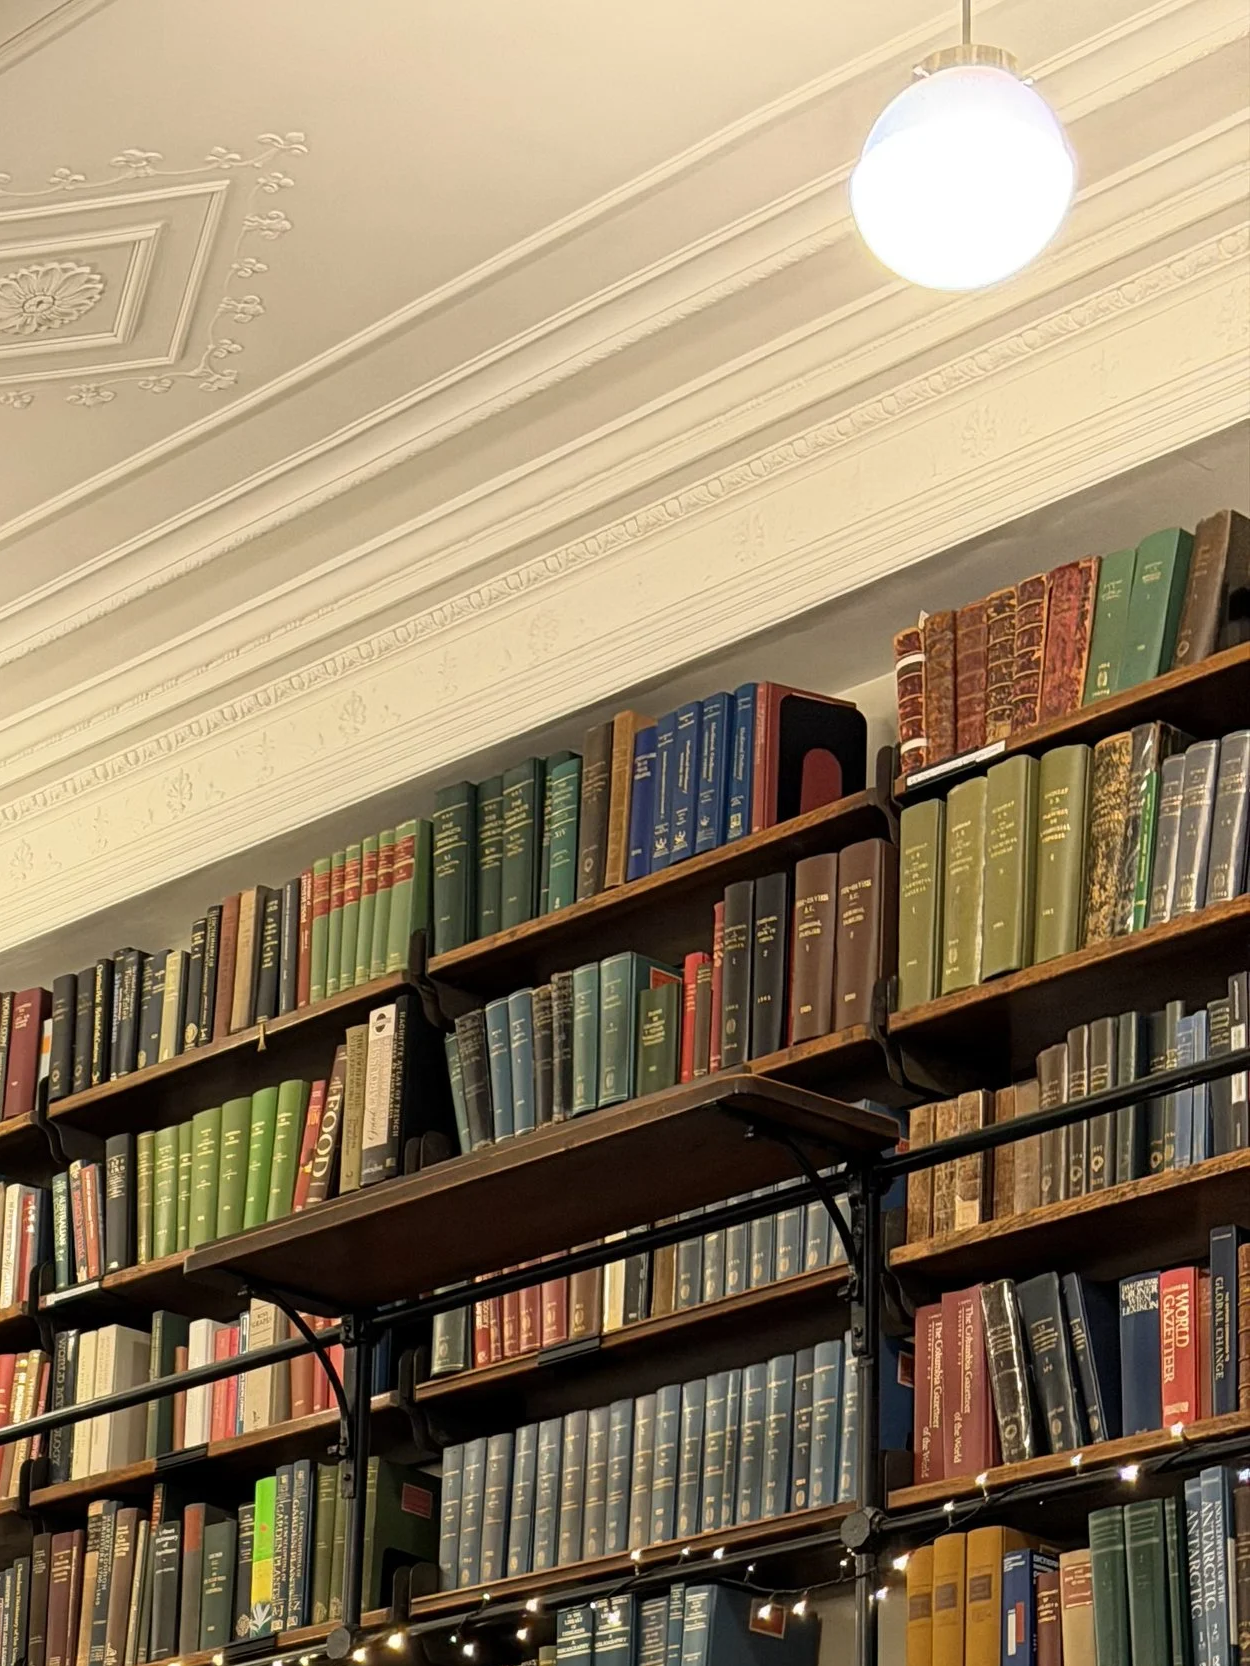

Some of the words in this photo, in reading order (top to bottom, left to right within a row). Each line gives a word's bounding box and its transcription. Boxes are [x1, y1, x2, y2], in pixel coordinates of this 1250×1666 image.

[312, 1094, 342, 1178] FOOD
[964, 1304, 974, 1323] The
[1176, 1291, 1190, 1348] WORLD
[1215, 1277, 1224, 1326] GLOBAL
[934, 1321, 943, 1339] The
[964, 1326, 974, 1369] Columbia
[1163, 1294, 1175, 1384] GAZETTEER
[1215, 1328, 1225, 1380] CHANGE
[56, 1337, 67, 1384] WORLD
[933, 1340, 943, 1386] Columbia
[52, 1387, 64, 1467] MYOLOGY
[953, 1423, 962, 1436] the
[954, 1412, 962, 1422] of
[953, 1437, 962, 1464] World
[274, 1503, 284, 1554] GARDEN
[290, 1499, 301, 1549] GARDEN
[272, 1556, 282, 1599] PLANTS
[1186, 1510, 1202, 1619] ANTARCTIC
[1202, 1501, 1217, 1611] ANTARCTIC
[13, 1596, 21, 1628] Dictionary
